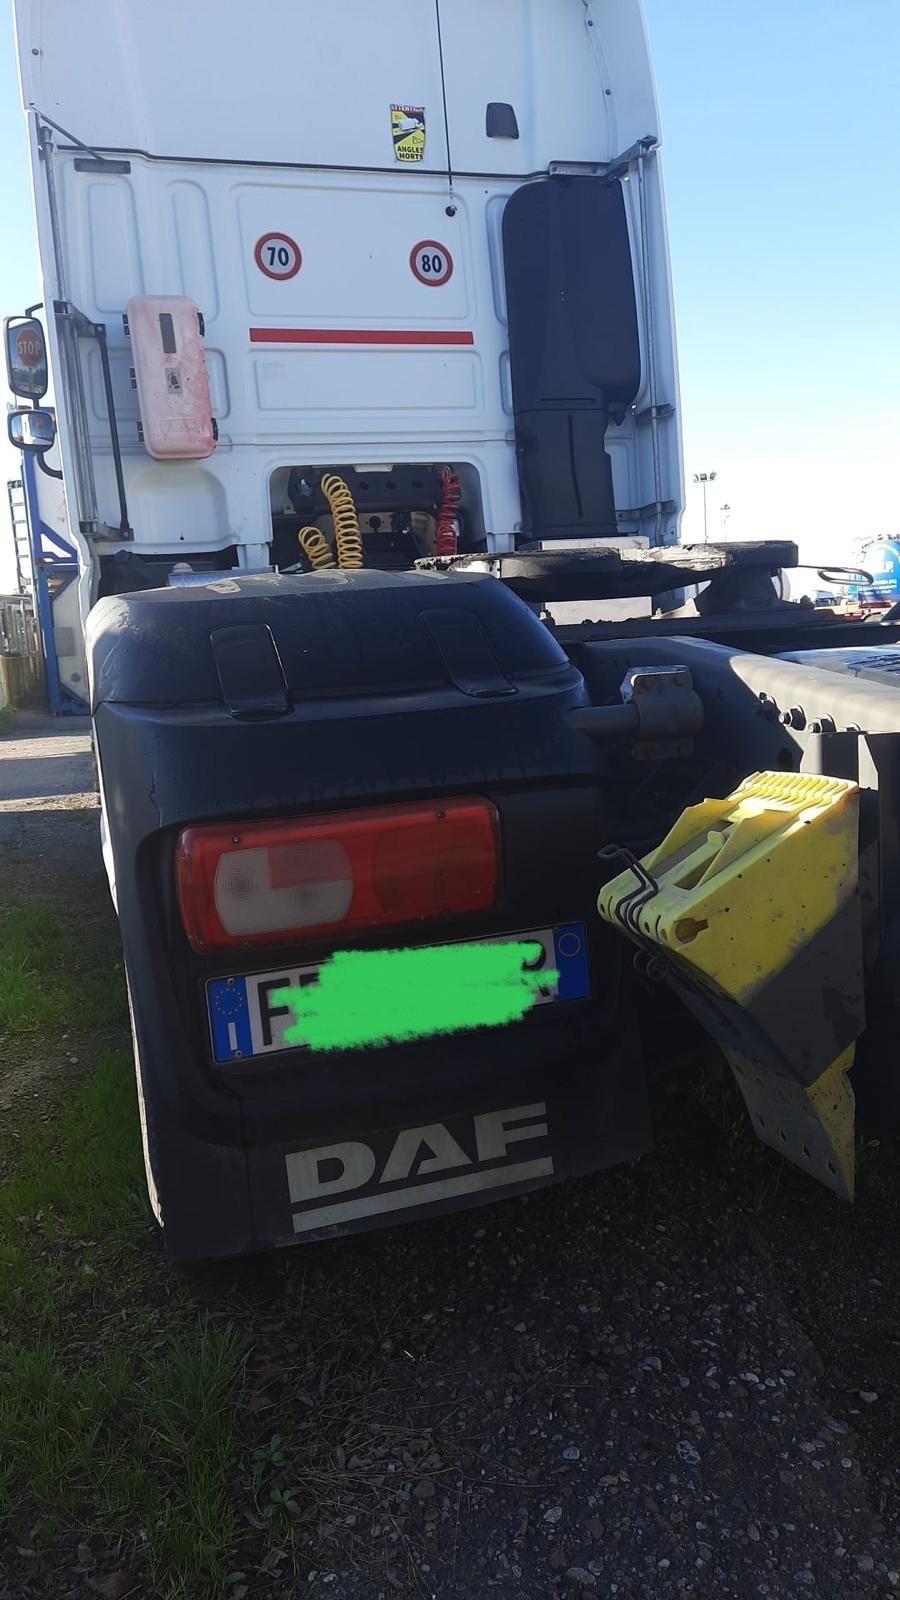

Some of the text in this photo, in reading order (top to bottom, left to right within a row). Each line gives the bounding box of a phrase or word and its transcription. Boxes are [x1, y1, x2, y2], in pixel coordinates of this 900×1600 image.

[397, 146, 424, 154] ANGLES
[266, 246, 289, 267] 70
[421, 254, 442, 274] 80
[18, 341, 41, 355] STOP
[285, 1101, 548, 1204] DAF
